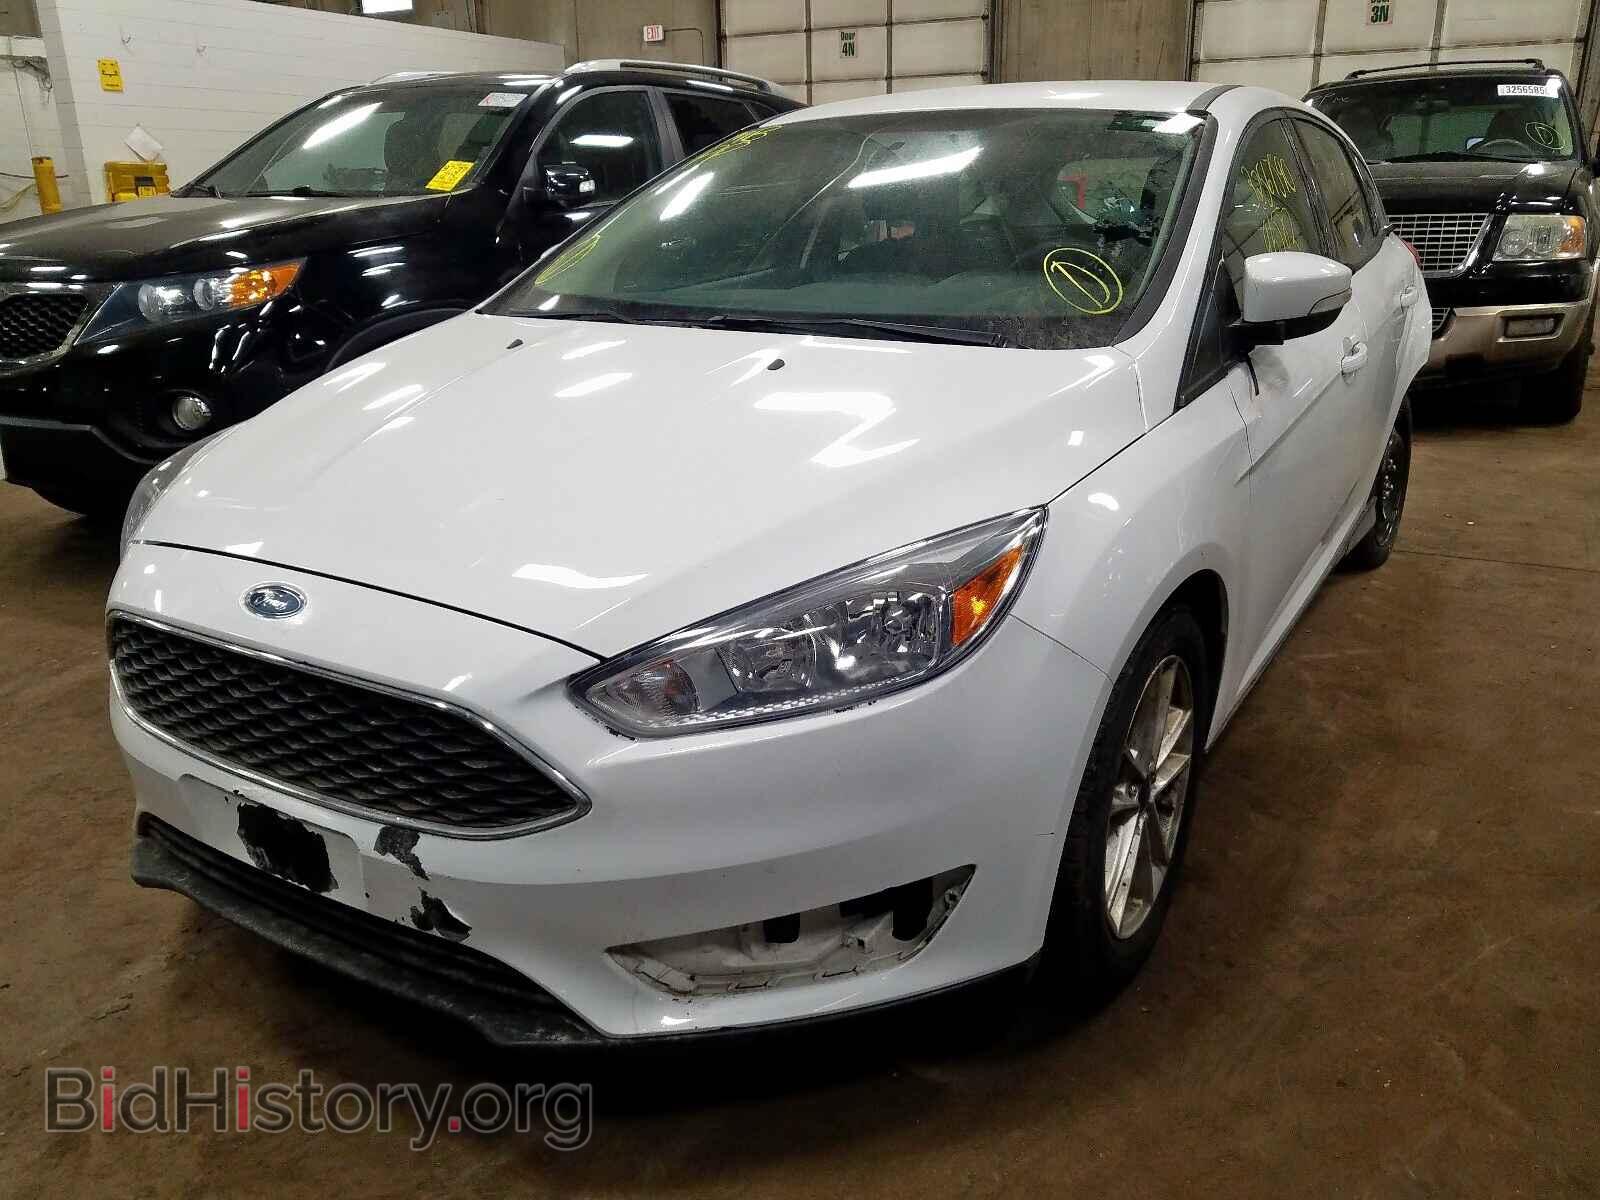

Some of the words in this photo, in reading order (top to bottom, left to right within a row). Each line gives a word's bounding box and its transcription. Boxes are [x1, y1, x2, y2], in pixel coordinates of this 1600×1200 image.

[1371, 5, 1390, 23] 3N
[647, 26, 660, 40] EXIT
[840, 31, 856, 41] Door
[842, 42, 855, 57] 4N
